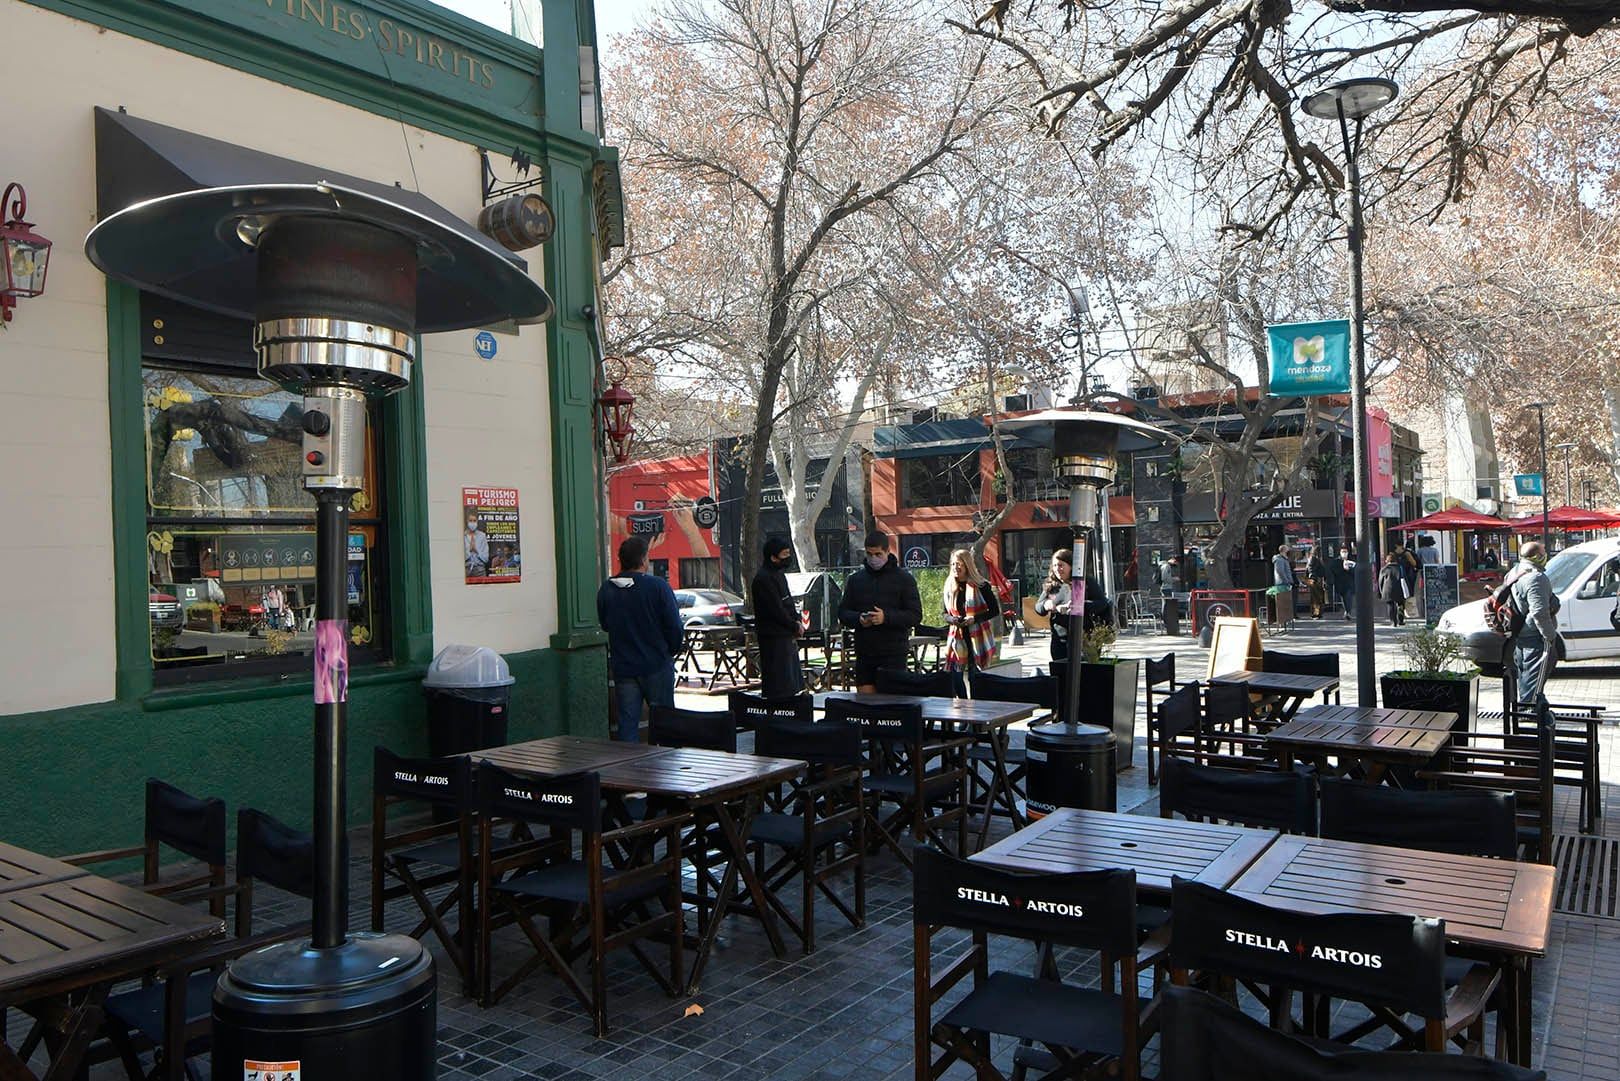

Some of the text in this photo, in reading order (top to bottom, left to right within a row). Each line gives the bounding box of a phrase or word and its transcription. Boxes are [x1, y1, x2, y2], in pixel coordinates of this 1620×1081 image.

[264, 0, 496, 90] INES SPIRITS
[1287, 364, 1332, 375] mendoza
[478, 489, 516, 499] TURISMO
[481, 498, 516, 506] PELIGRO
[747, 707, 796, 717] STELLA ARTOIS
[876, 719, 902, 727] ARTOIS
[394, 771, 449, 785] STELLA ARTOIS
[504, 788, 573, 804] STELLA ARTOIS
[957, 887, 1083, 917] STELLA ARTOIS
[1225, 929, 1382, 969] STELLA ARTOIS
